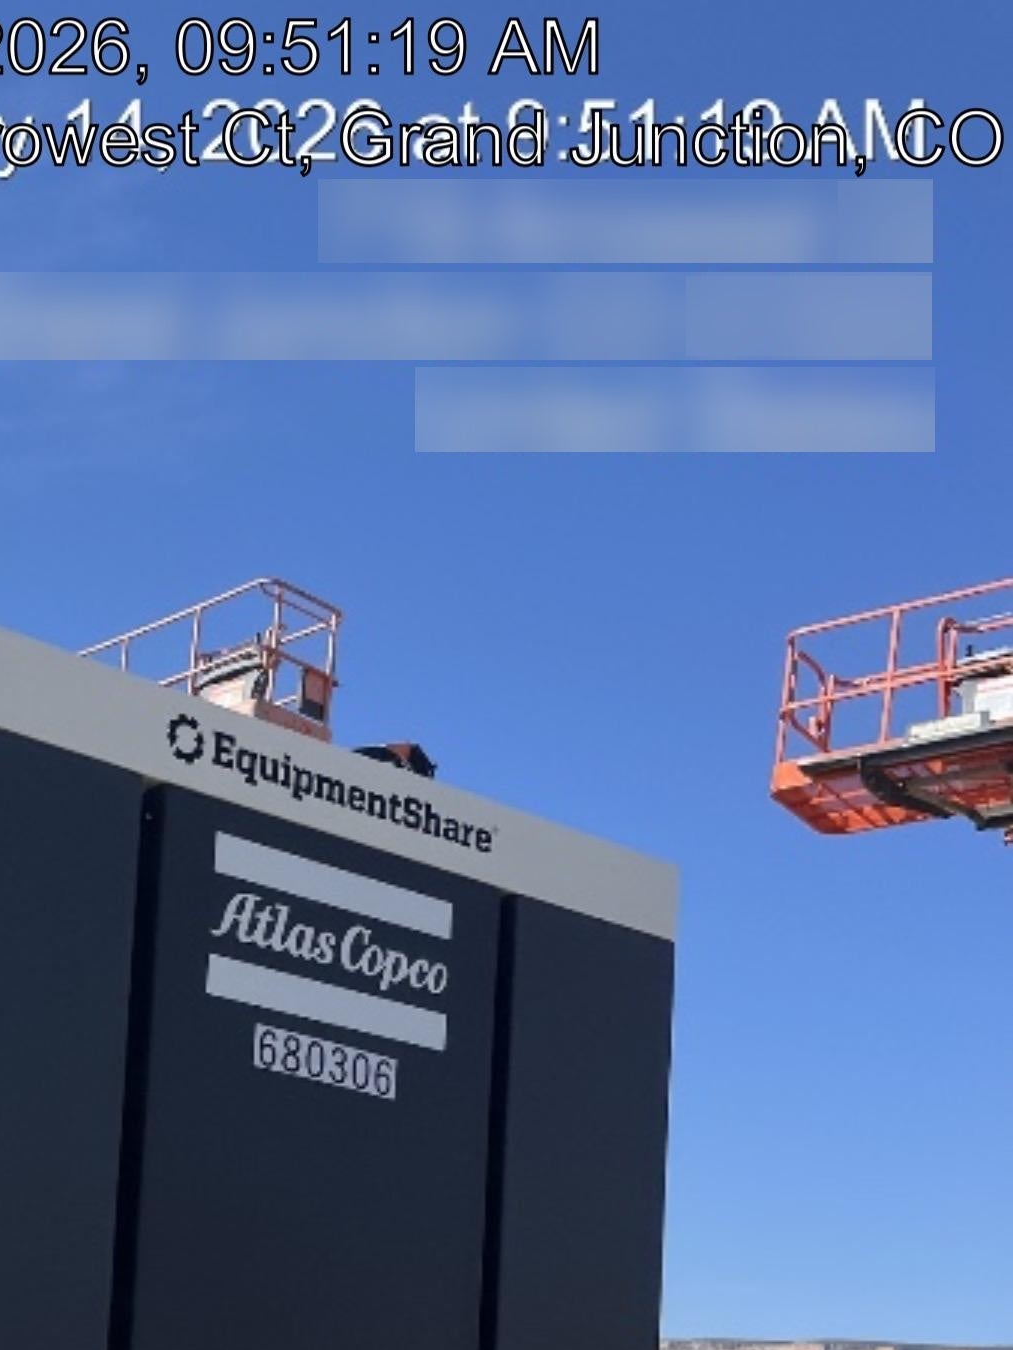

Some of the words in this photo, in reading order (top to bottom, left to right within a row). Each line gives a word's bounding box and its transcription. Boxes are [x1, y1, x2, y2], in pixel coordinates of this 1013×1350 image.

[212, 731, 492, 853] EquipmentShare
[210, 893, 337, 965] Atlas
[340, 926, 449, 994] Copco
[258, 1027, 395, 1096] 680306
